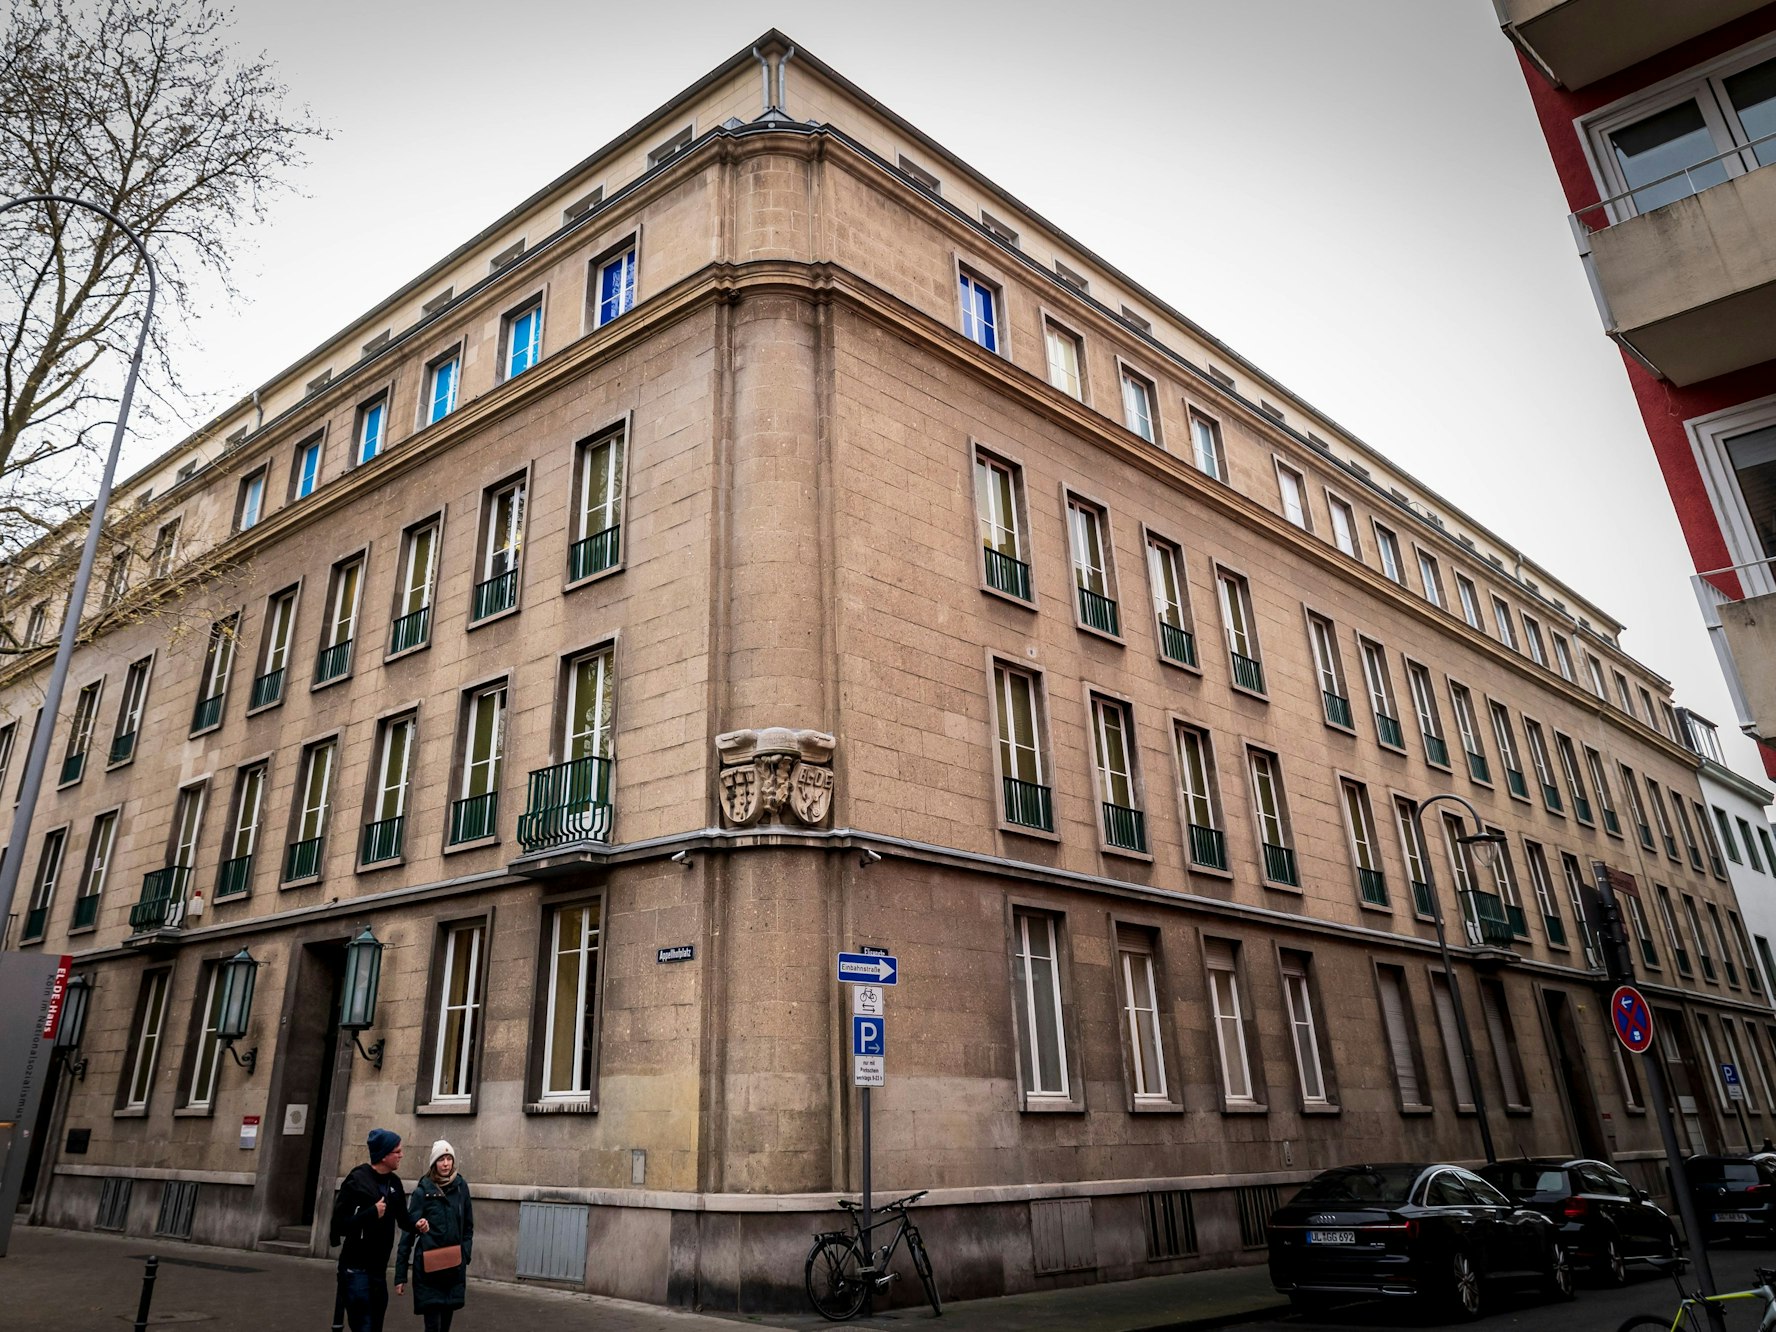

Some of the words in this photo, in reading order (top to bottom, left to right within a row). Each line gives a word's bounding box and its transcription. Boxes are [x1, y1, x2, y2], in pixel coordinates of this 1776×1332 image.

[841, 963, 880, 974] Einbahnstraße
[41, 1000, 48, 1011] im
[860, 1021, 878, 1053] P
[15, 1015, 46, 1120] Nationalsozialismus
[1723, 1066, 1733, 1083] P
[1339, 1232, 1354, 1242] 692
